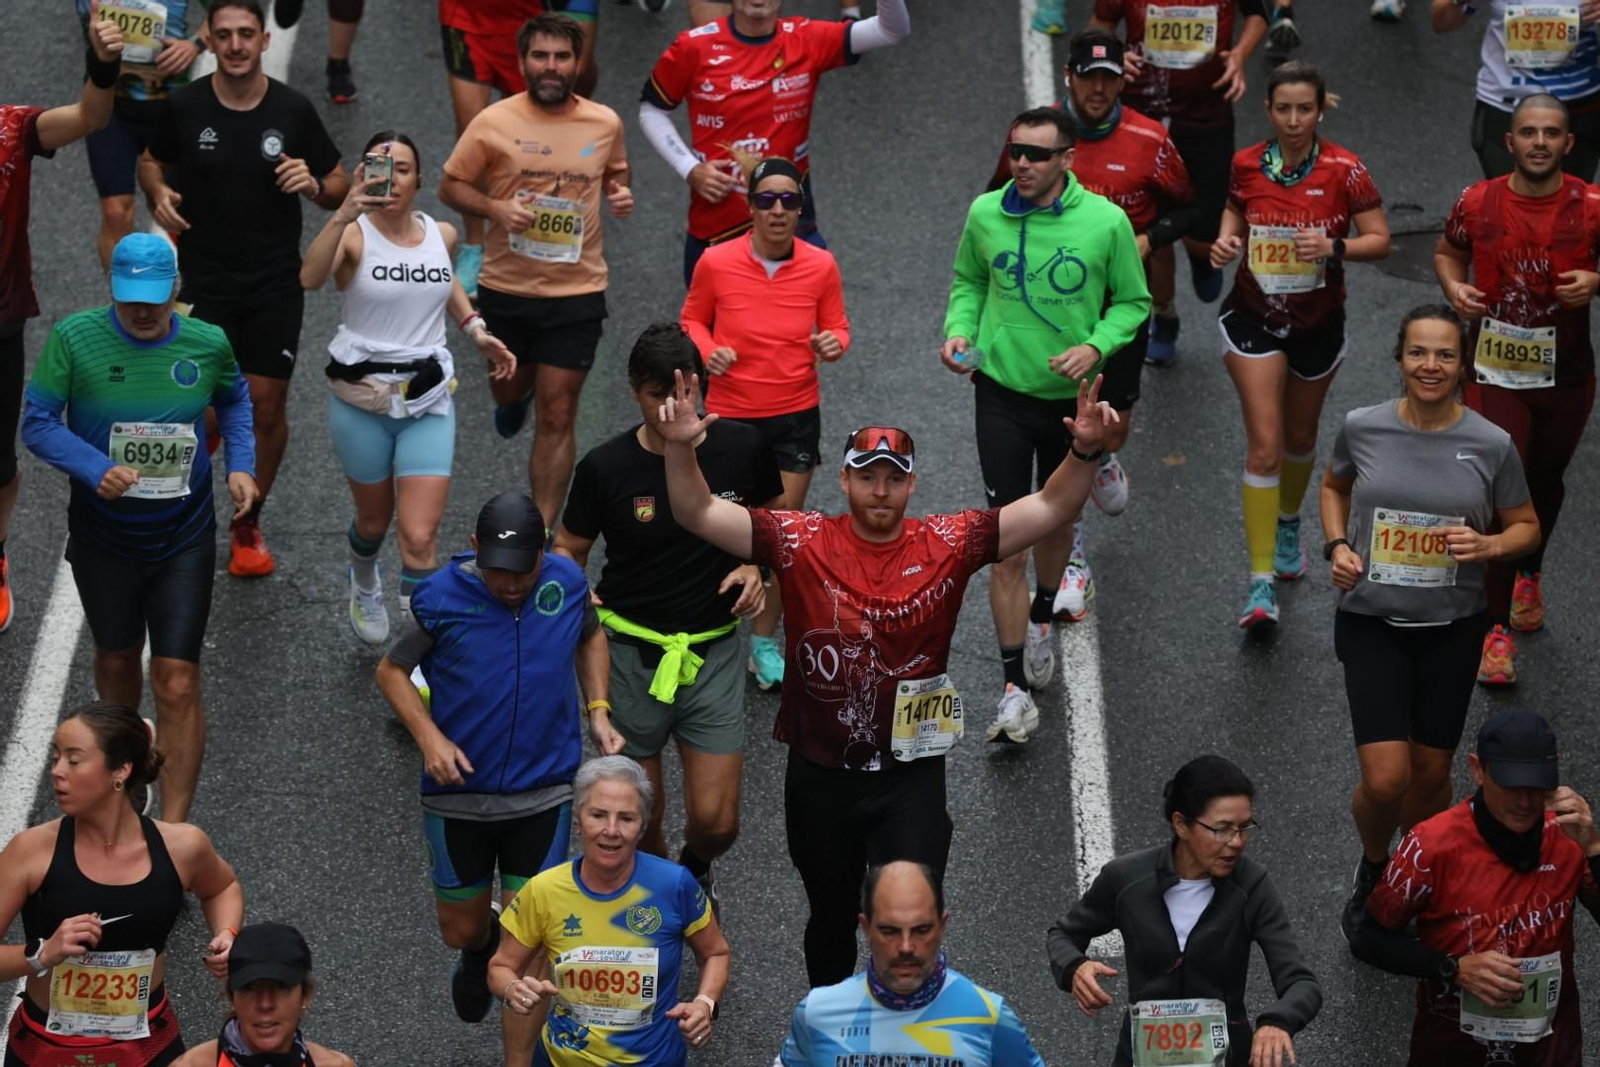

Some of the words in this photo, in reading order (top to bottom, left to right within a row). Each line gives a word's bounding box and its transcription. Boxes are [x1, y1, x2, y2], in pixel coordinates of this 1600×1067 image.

[1151, 22, 1205, 41] 12012
[1510, 21, 1567, 40] 13278
[696, 113, 724, 129] AVIS
[371, 262, 451, 284] adidas
[1484, 337, 1542, 363] 11893
[123, 441, 178, 466] 6934
[1380, 527, 1447, 555] 12108
[803, 642, 840, 682] 30
[903, 694, 953, 726] 14170
[920, 723, 938, 734] 14170
[61, 968, 138, 1001] 12233
[564, 968, 641, 995] 10693
[1142, 1021, 1205, 1051] 7892
